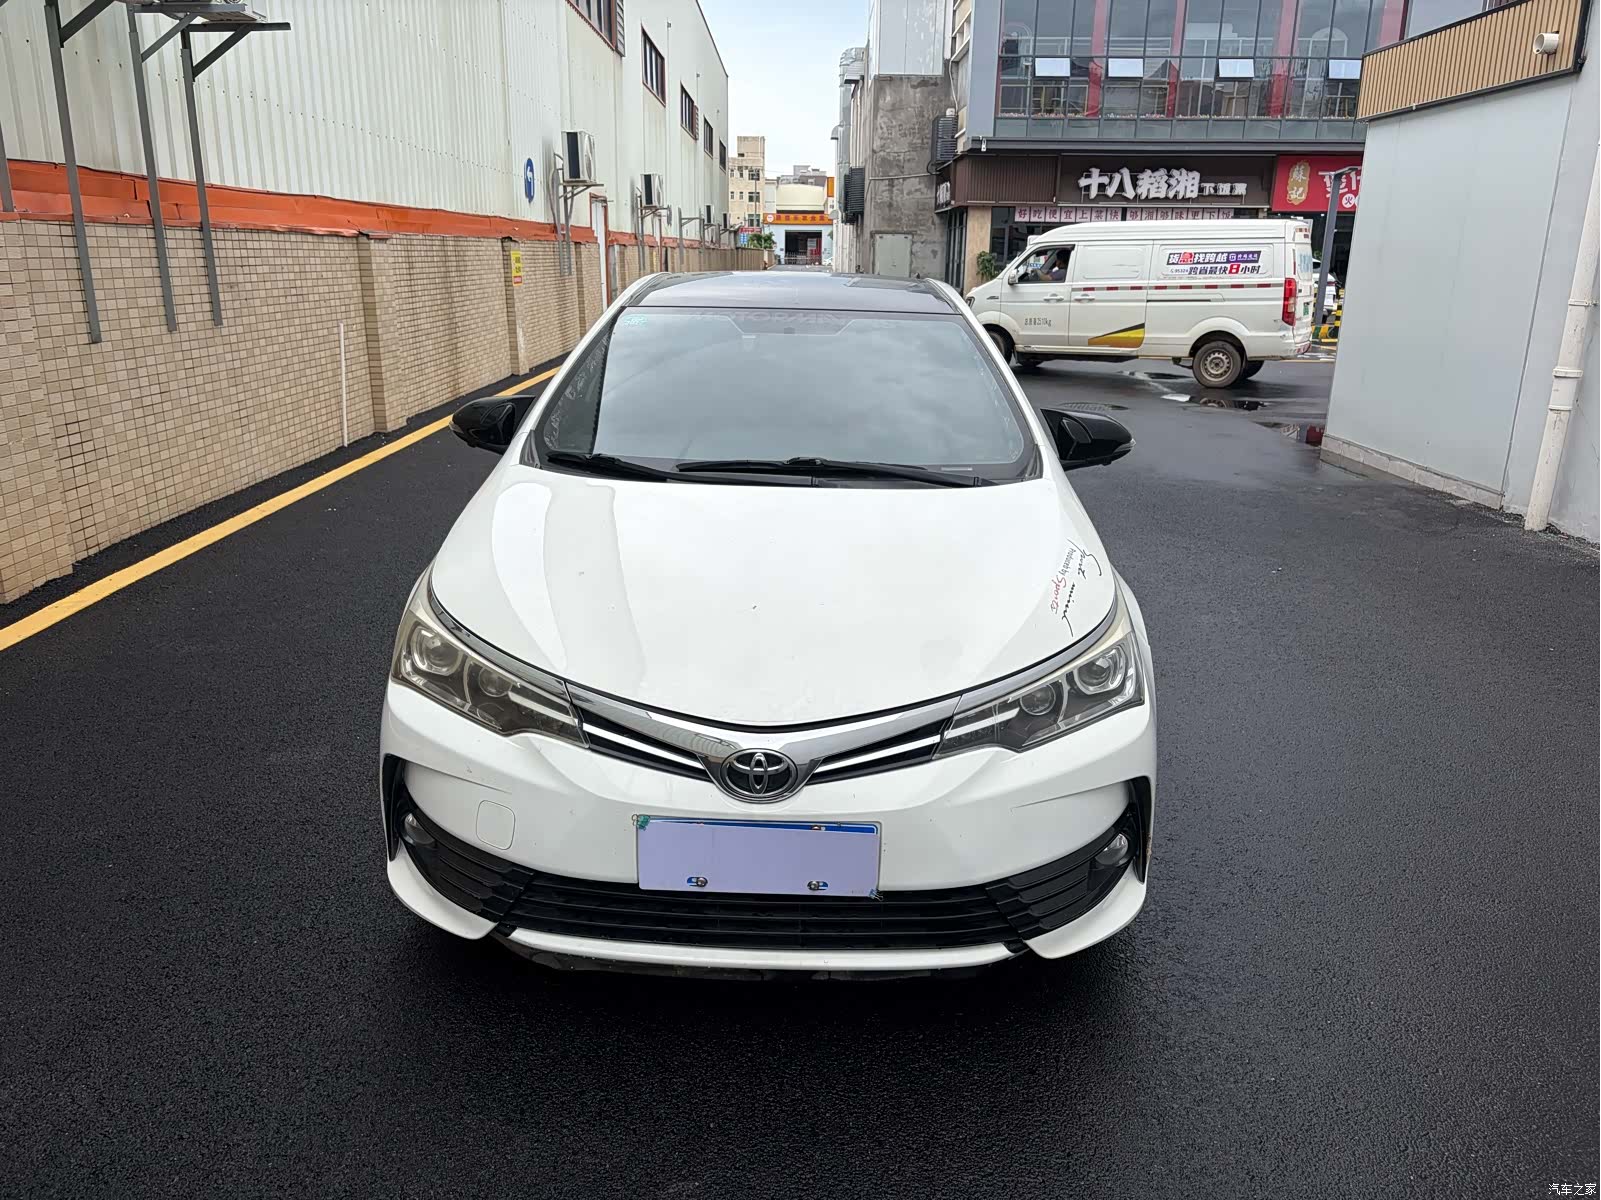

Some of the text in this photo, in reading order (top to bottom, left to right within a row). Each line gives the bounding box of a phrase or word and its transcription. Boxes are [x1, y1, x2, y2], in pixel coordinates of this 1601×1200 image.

[1078, 167, 1201, 200] 十八稻湘
[1017, 208, 1121, 221] 好吃便宜上菜快
[1050, 575, 1067, 615] Sports
